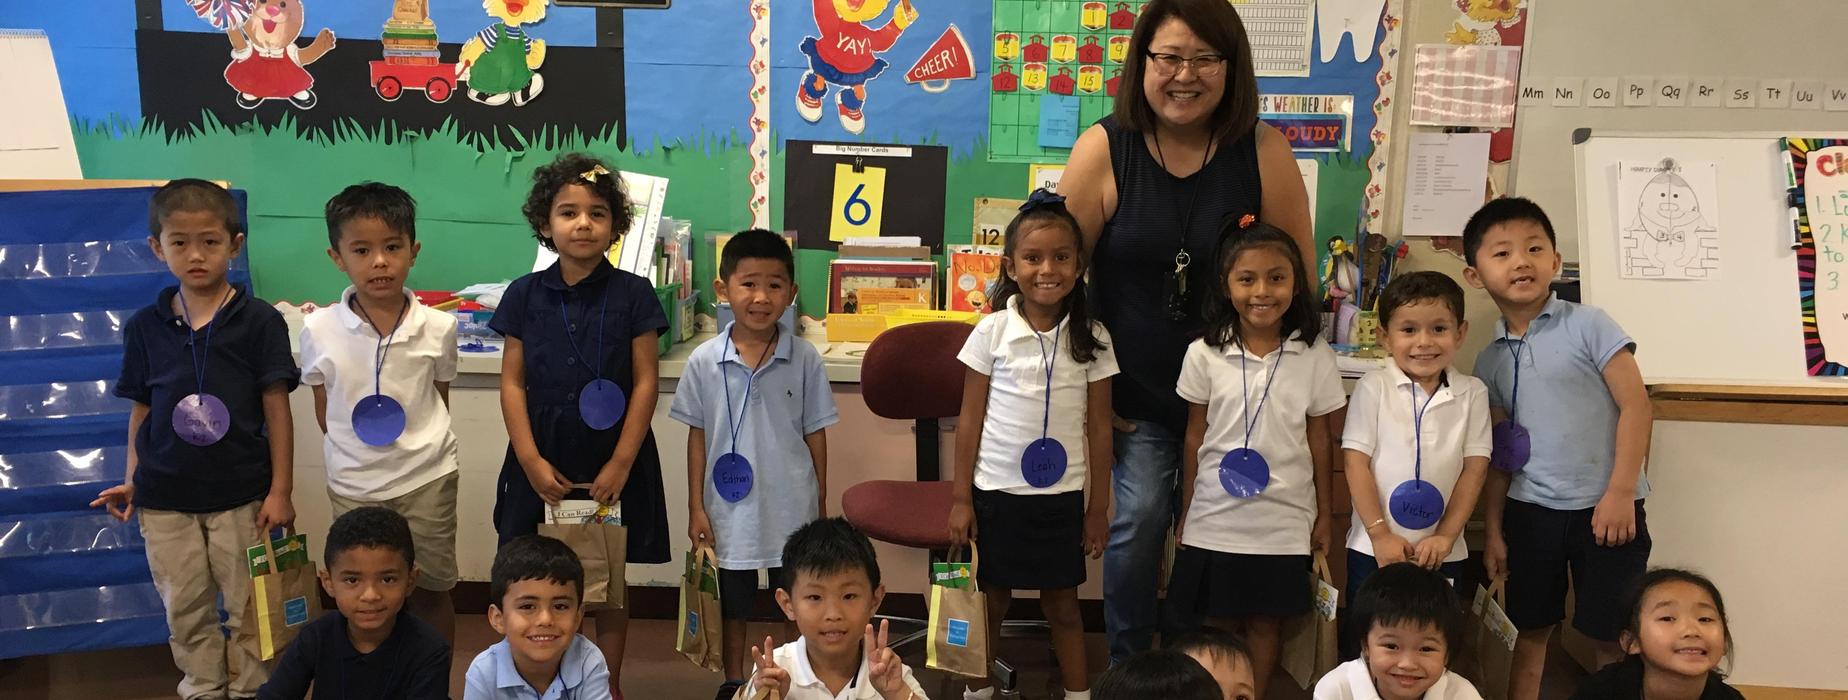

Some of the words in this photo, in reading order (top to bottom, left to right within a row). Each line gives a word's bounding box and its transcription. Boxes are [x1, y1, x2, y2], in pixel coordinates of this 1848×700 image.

[836, 31, 872, 55] YAY!
[1002, 44, 1009, 53] 5
[1060, 44, 1067, 56] 7
[1115, 44, 1123, 56] 9
[914, 46, 959, 79] CHEER!
[1027, 73, 1039, 84] 13
[1083, 75, 1094, 86] 15
[1522, 87, 1544, 99] Mm
[1555, 88, 1573, 99] Nn
[1593, 88, 1610, 99] Oo
[1629, 84, 1644, 99] Pp
[1661, 85, 1681, 99] Qq
[1698, 85, 1714, 97] Rr
[1733, 89, 1749, 100] Ss
[1766, 87, 1781, 99] Tt
[1796, 91, 1813, 102] Uu
[1831, 89, 1847, 101] Vv
[1273, 96, 1319, 113] WEATHER
[1277, 125, 1340, 141] OUDY
[1816, 152, 1848, 176] Cl
[844, 184, 871, 226] 6
[982, 228, 999, 245] 12
[1823, 245, 1844, 263] to
[1827, 271, 1839, 290] 3
[918, 292, 927, 304] K
[1031, 457, 1056, 473] Leah
[1402, 500, 1434, 518] Victor
